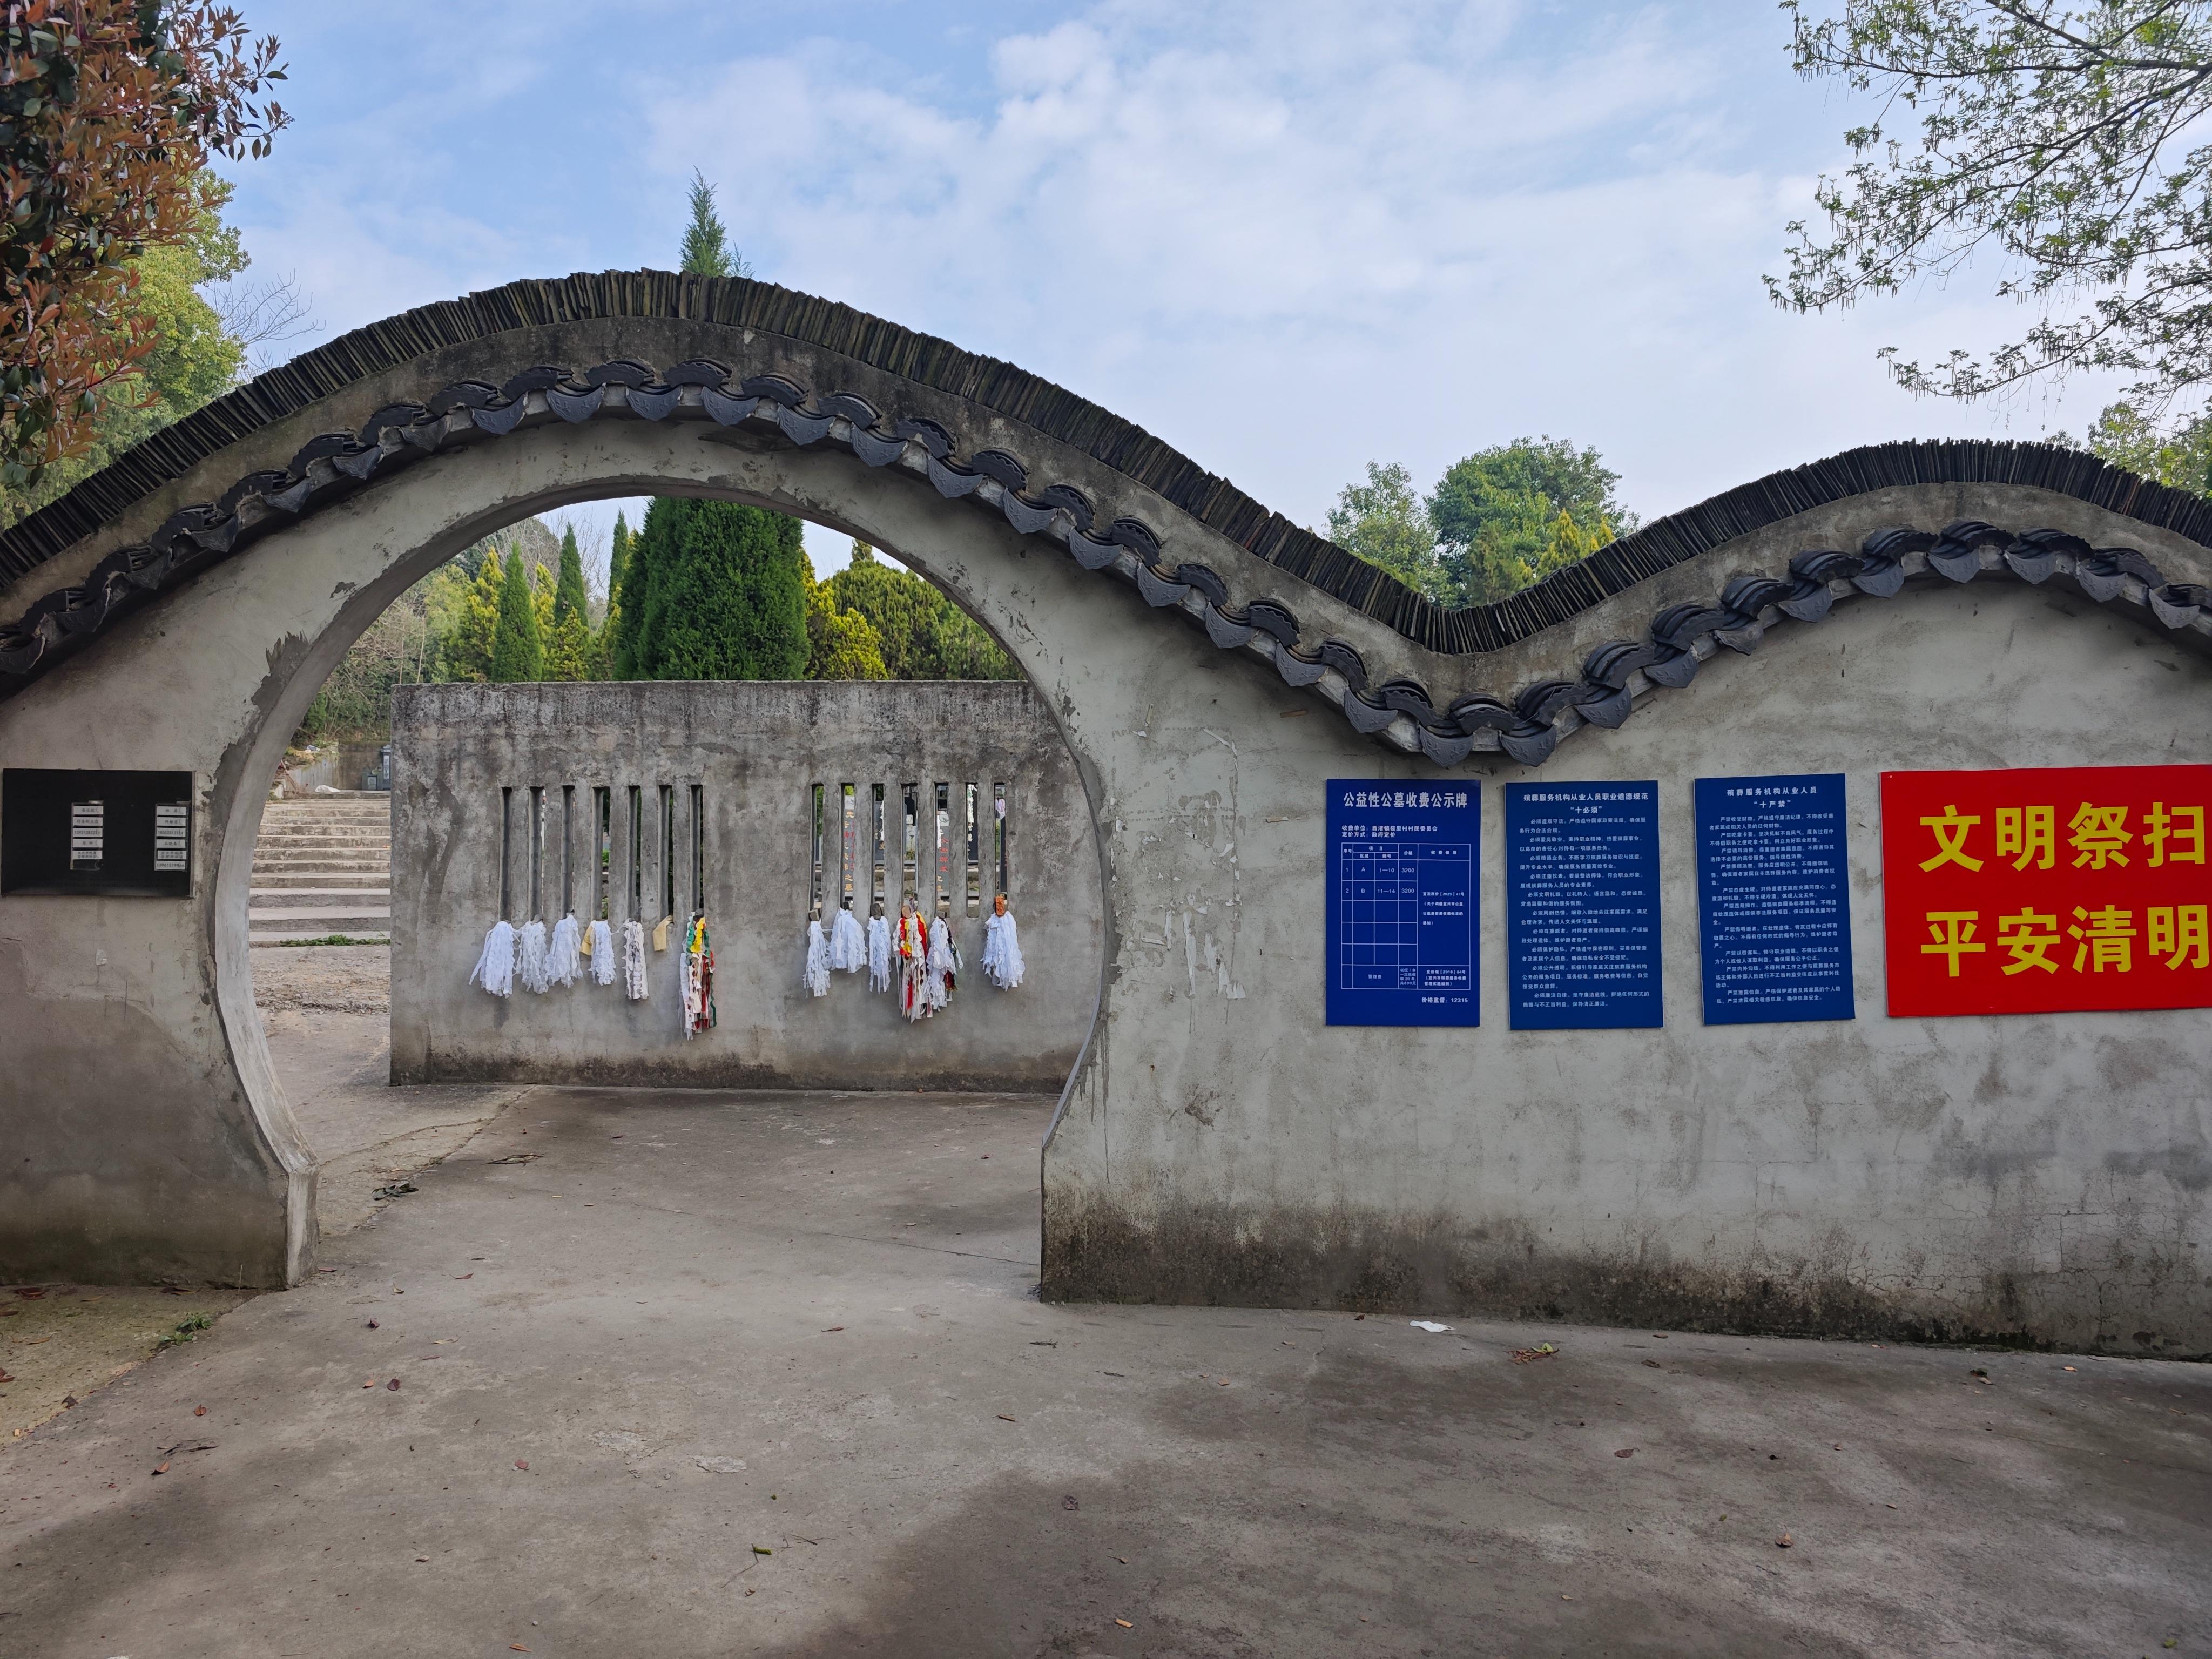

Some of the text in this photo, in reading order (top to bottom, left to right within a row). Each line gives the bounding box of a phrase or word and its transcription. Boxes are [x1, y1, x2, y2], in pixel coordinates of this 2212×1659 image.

[1343, 791, 1468, 808] 公益性公墓收费公示牌
[1523, 793, 1648, 801] 殡葬服务机构从业人员职业道德规范
[1727, 786, 1817, 797] 殡葬服务机构从业人员
[1918, 801, 2206, 873] 文明祭扫
[1920, 905, 2210, 977] 平安清明
